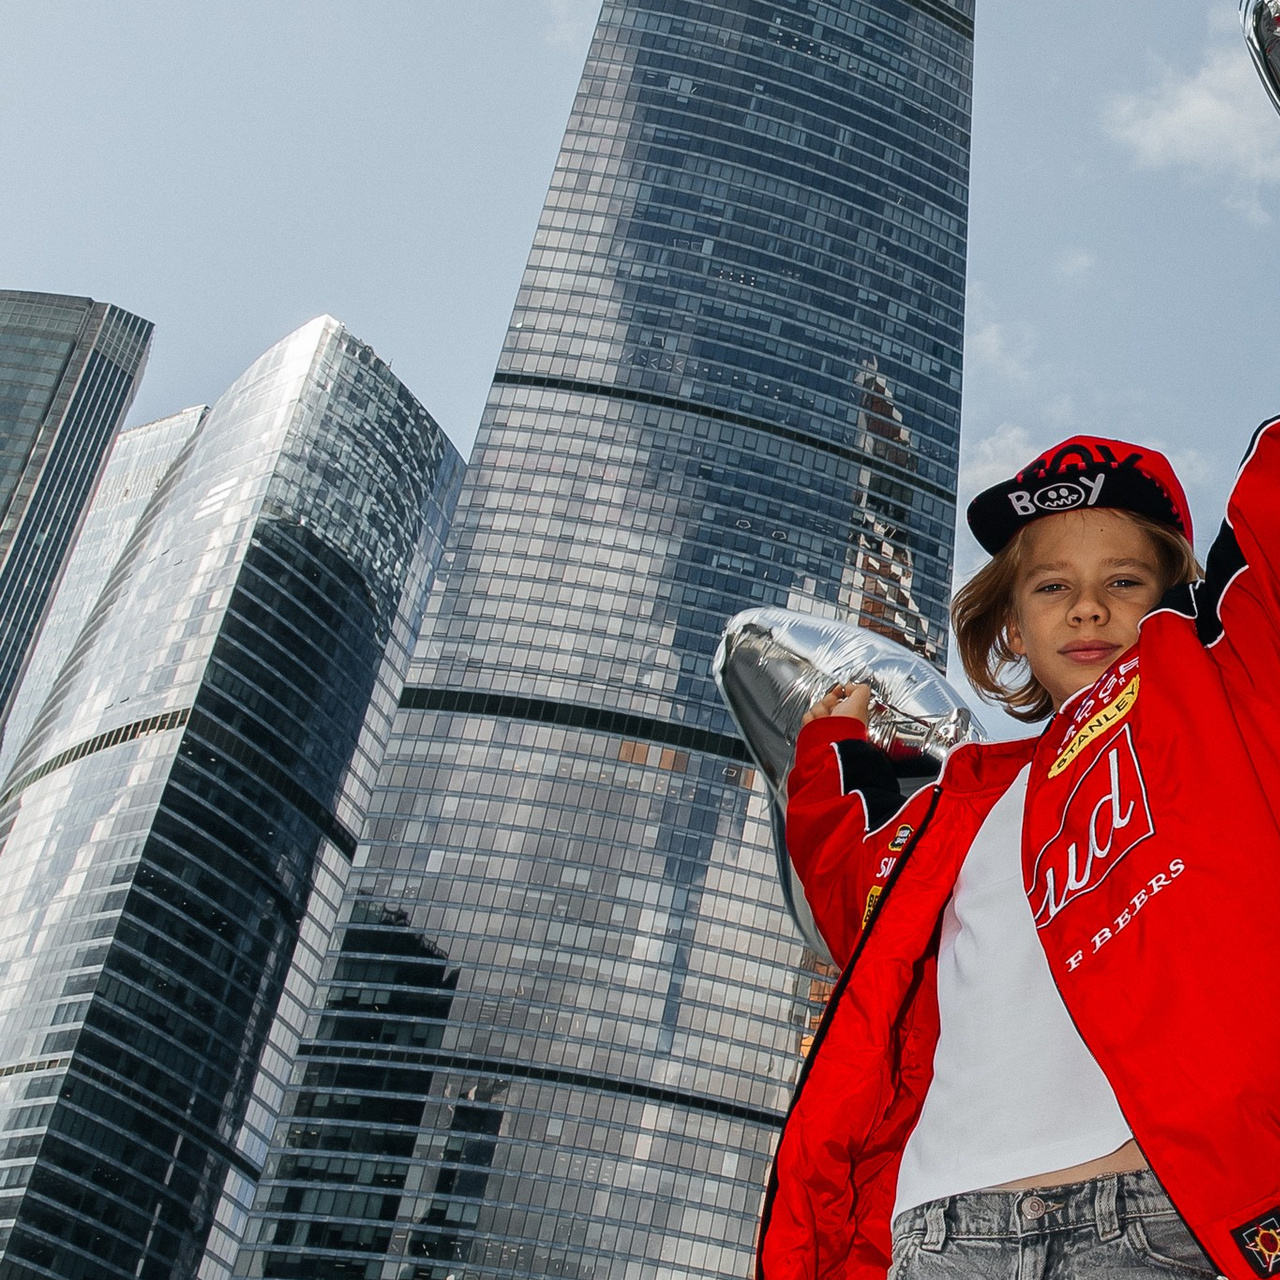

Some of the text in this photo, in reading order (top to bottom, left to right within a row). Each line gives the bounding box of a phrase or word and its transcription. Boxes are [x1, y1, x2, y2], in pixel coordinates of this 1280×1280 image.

[1008, 473, 1105, 516] BOY
[1056, 683, 1136, 770] STANLEY
[1090, 858, 1186, 954] BEERS
